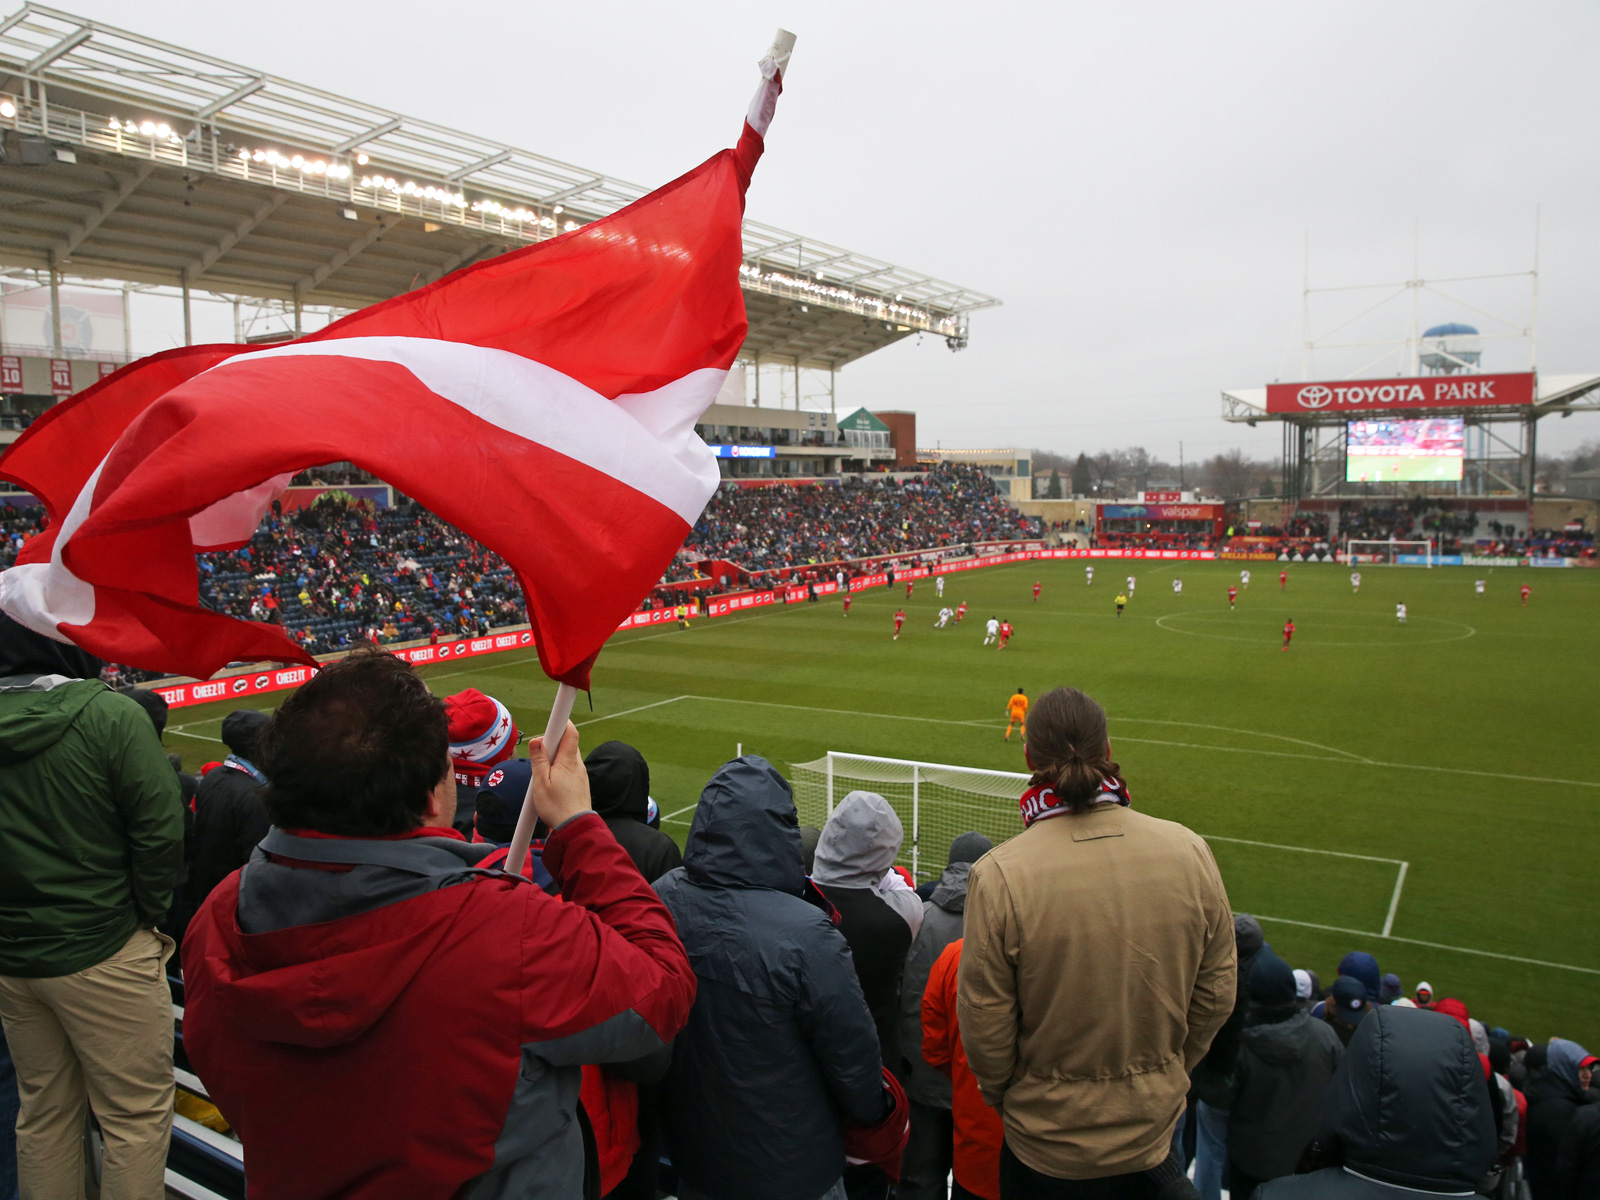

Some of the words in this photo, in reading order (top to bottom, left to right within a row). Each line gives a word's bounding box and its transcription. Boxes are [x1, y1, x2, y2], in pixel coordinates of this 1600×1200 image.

[3, 369, 20, 383] 10
[54, 372, 70, 386] 41
[1334, 385, 1425, 404] TOYOTA
[1434, 381, 1495, 400] PARK
[1161, 505, 1200, 518] valspar
[1220, 552, 1247, 560] WELLS
[1250, 552, 1276, 560] FARGO
[1463, 556, 1518, 566] Heineken
